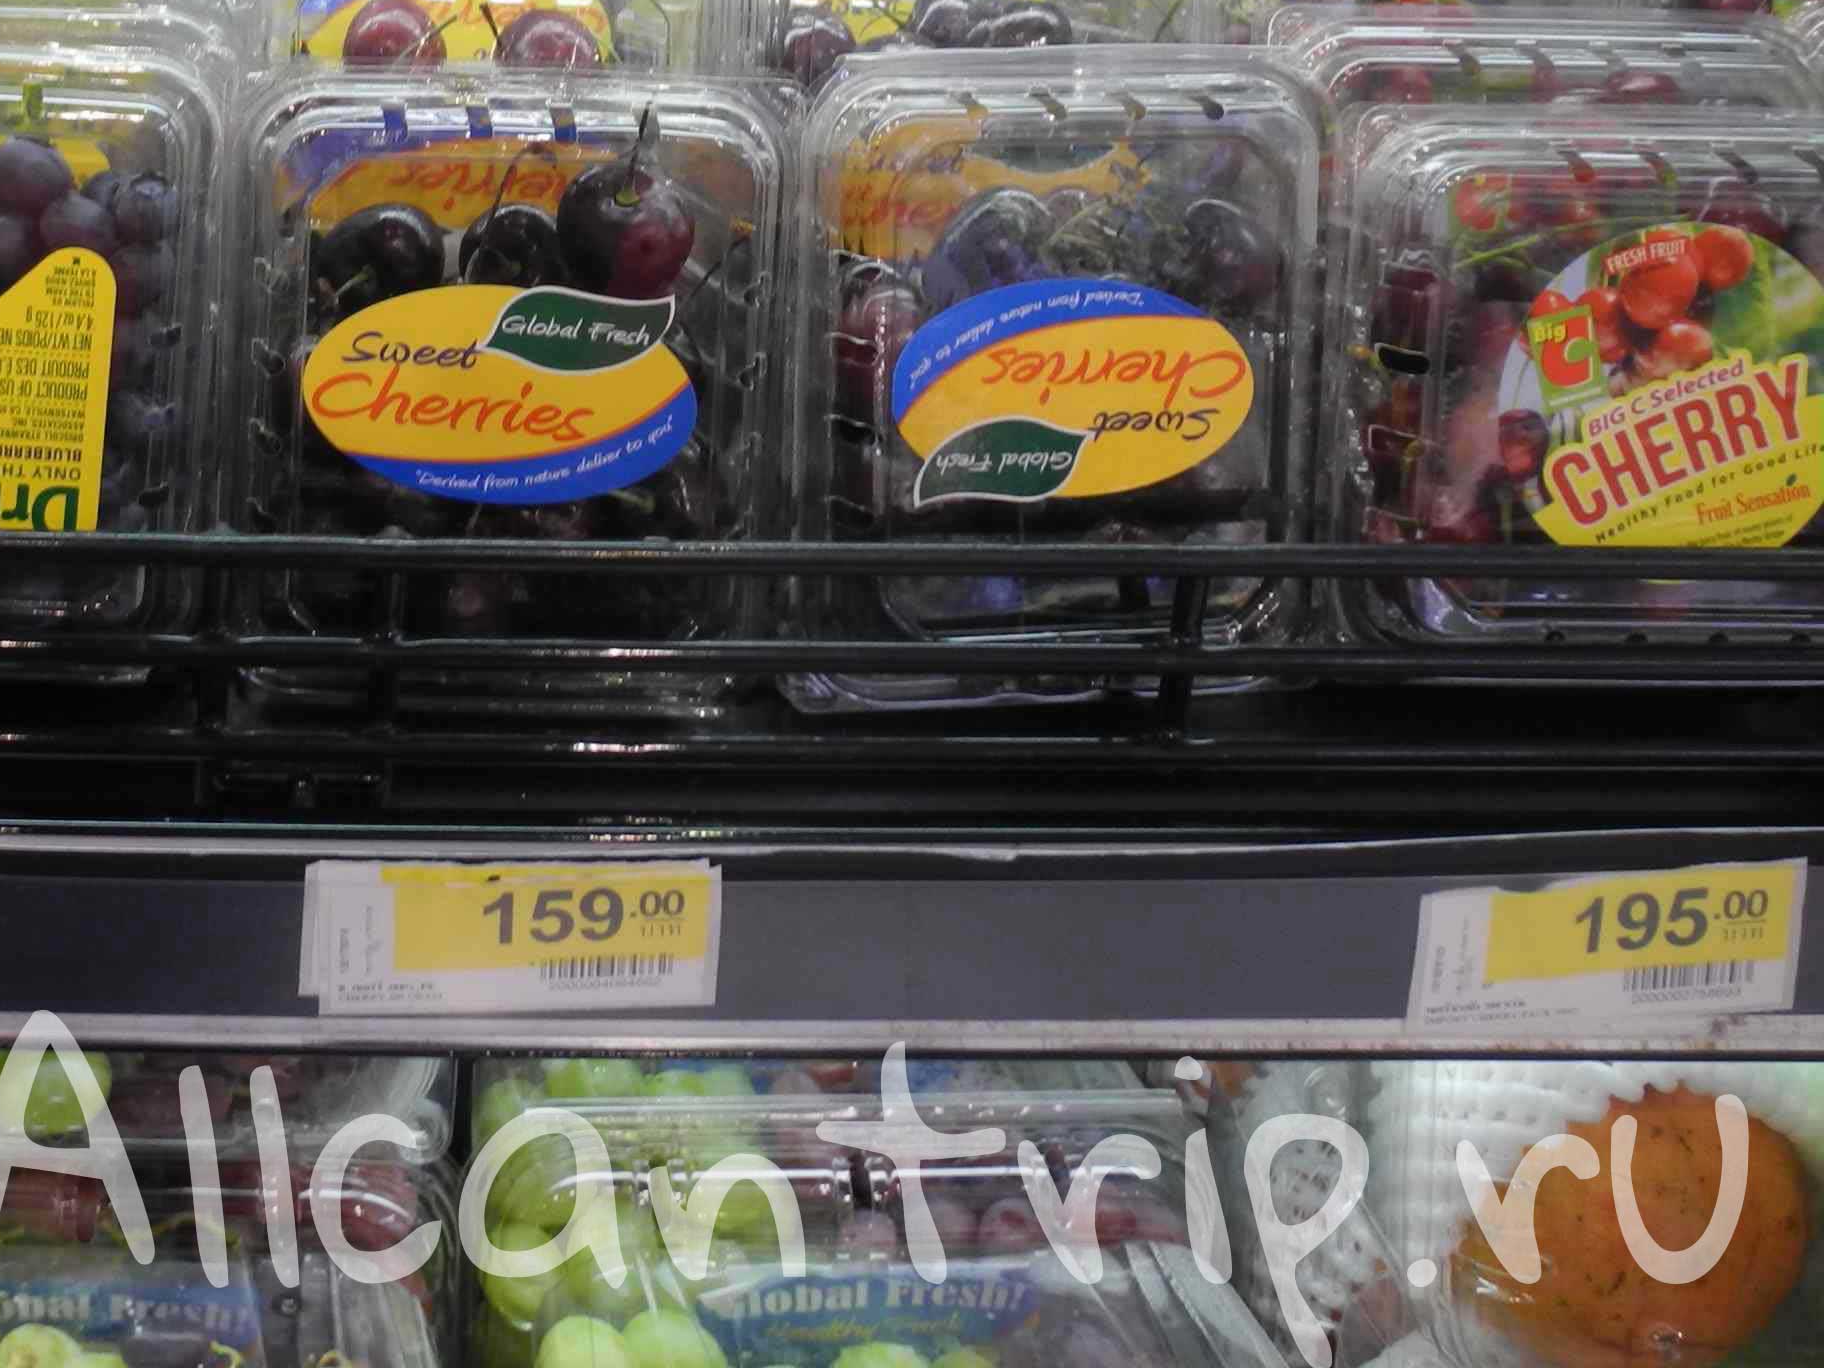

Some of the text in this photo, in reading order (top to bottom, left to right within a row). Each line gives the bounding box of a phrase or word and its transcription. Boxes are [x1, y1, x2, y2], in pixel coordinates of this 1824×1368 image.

[1606, 237, 1687, 275] FRESH FRUIT
[502, 314, 650, 346] Global Fresh
[1534, 322, 1569, 344] Big
[16, 358, 37, 377] DES
[341, 331, 482, 371] Sweet
[39, 359, 89, 380] PRODUIT
[980, 347, 1247, 409] Cherries
[18, 381, 32, 396] OF
[35, 381, 88, 402] PRODUCT
[312, 364, 594, 442] Cherries
[1588, 358, 1746, 438] BIG C Selected
[1087, 407, 1221, 442] Sweet
[935, 450, 1073, 474] Global Fresh
[1551, 361, 1802, 527] CHERRY
[30, 466, 81, 482] ONLY
[483, 439, 643, 492] from nature deliver to
[1595, 504, 1660, 545] Healthy
[1663, 482, 1705, 507] Food
[1742, 453, 1787, 475] Good
[1696, 484, 1811, 525] Fruit Sensation
